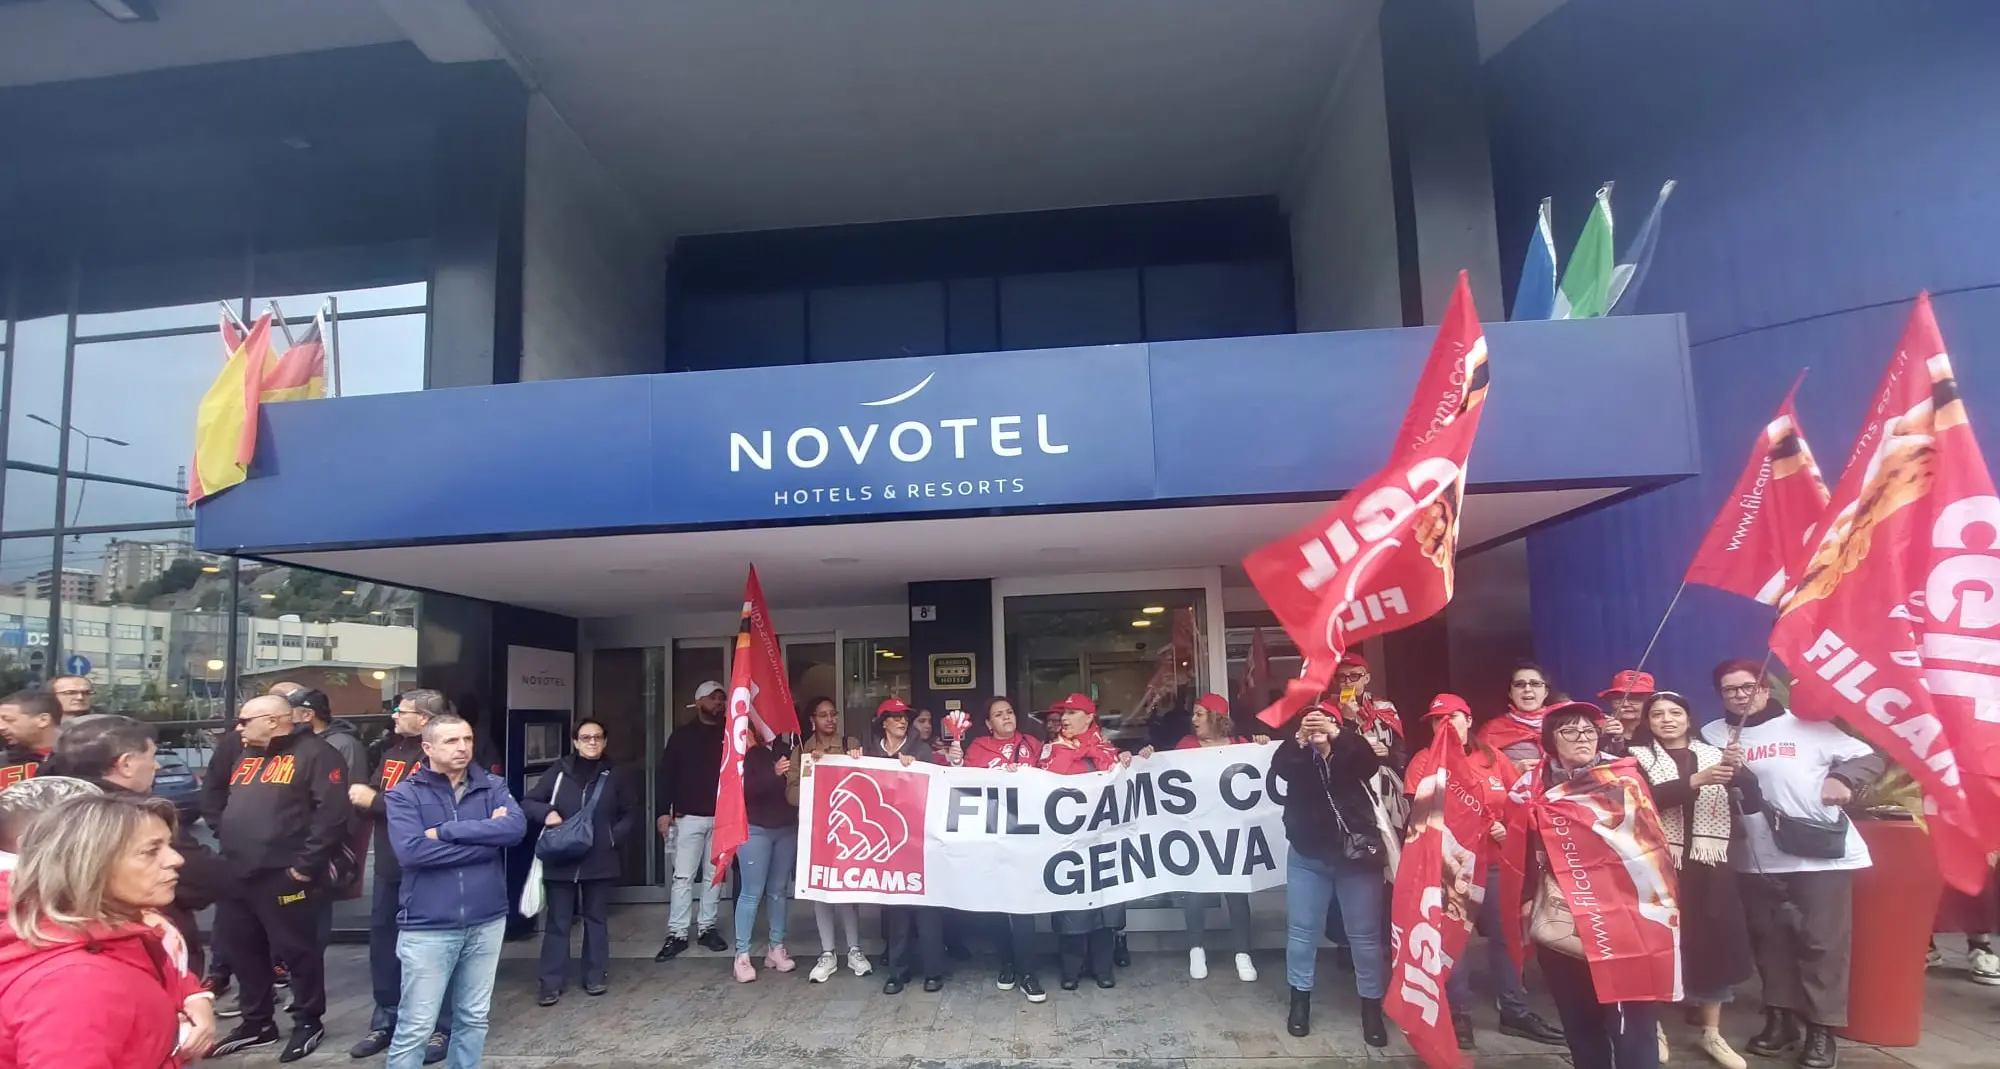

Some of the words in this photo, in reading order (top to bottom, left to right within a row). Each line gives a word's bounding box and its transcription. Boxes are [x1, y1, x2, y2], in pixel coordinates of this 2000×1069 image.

[730, 413, 1069, 472] NOVOTEL
[774, 485, 873, 505] HOTELS
[883, 484, 896, 499] &
[907, 478, 1025, 498] RESORTS
[521, 674, 566, 687] NOVOTEL
[1747, 743, 1777, 761] AMS
[945, 769, 1197, 835] FILCAMS
[1043, 825, 1277, 896] GENOVA
[809, 864, 923, 893] FILCAMS
